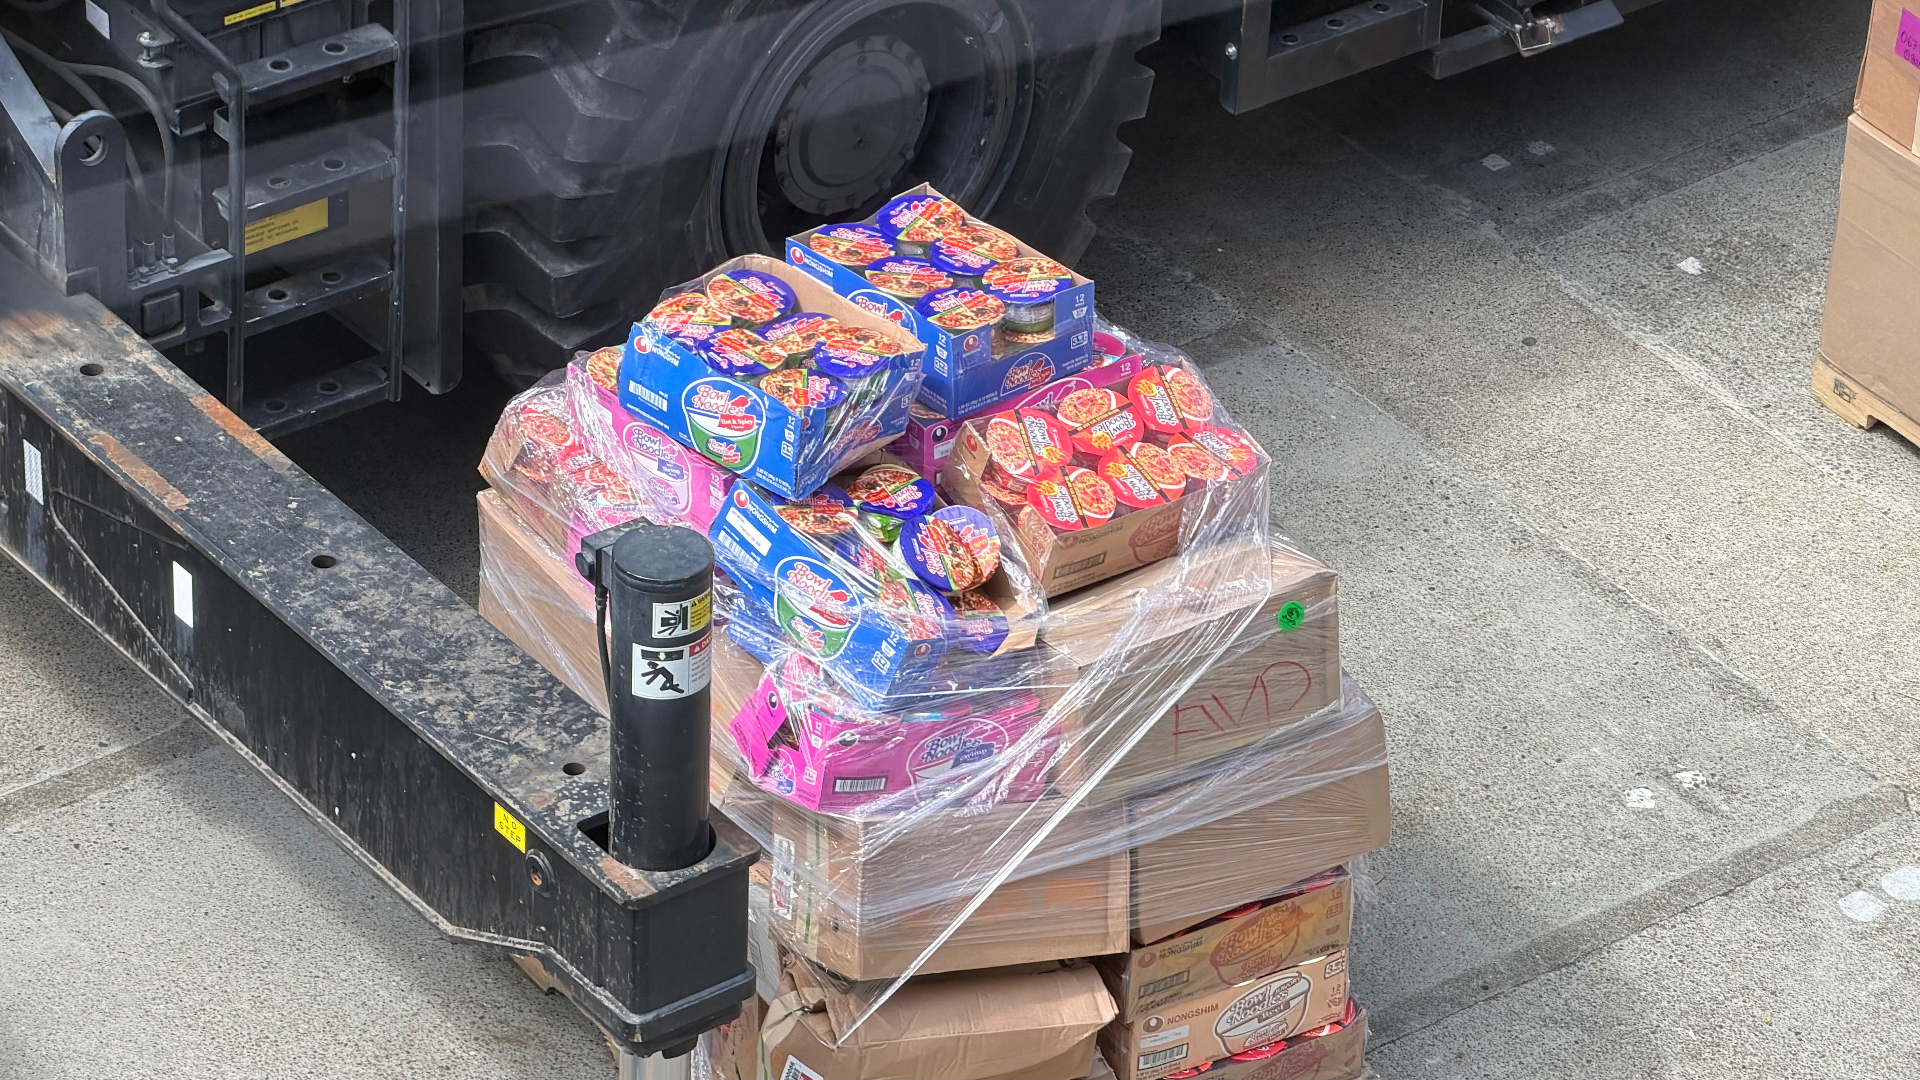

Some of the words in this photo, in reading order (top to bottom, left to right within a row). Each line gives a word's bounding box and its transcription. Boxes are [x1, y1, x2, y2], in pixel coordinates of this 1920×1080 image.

[1074, 293, 1085, 302] 12
[1008, 360, 1033, 381] Bowl
[1120, 362, 1131, 372] 12
[692, 395, 746, 416] Noodles
[697, 384, 731, 405] Bowl
[1149, 396, 1167, 425] Bowl
[1037, 416, 1054, 448] Bowl
[1091, 411, 1133, 435] Noodles
[1109, 417, 1136, 439] Bowl
[633, 426, 662, 446] Bowl
[1023, 415, 1044, 457] Noodles
[631, 435, 677, 462] Noodles
[1120, 476, 1147, 501] Bowl
[1048, 493, 1068, 522] Bowl
[747, 504, 779, 535] NONGSHIM
[794, 562, 833, 591] Bowl
[889, 631, 900, 642] 12
[921, 738, 982, 762] Noodles
[925, 728, 966, 750] Bowl
[499, 821, 521, 842] STEP
[503, 814, 517, 830] NO
[1222, 918, 1265, 946] Bowl
[1159, 939, 1203, 960] NONGSHIM
[1226, 989, 1290, 1026] Noodles
[1230, 984, 1272, 1014] Bowl
[1167, 1003, 1219, 1025] NONGSHIM
[1261, 1004, 1285, 1020] Beef
